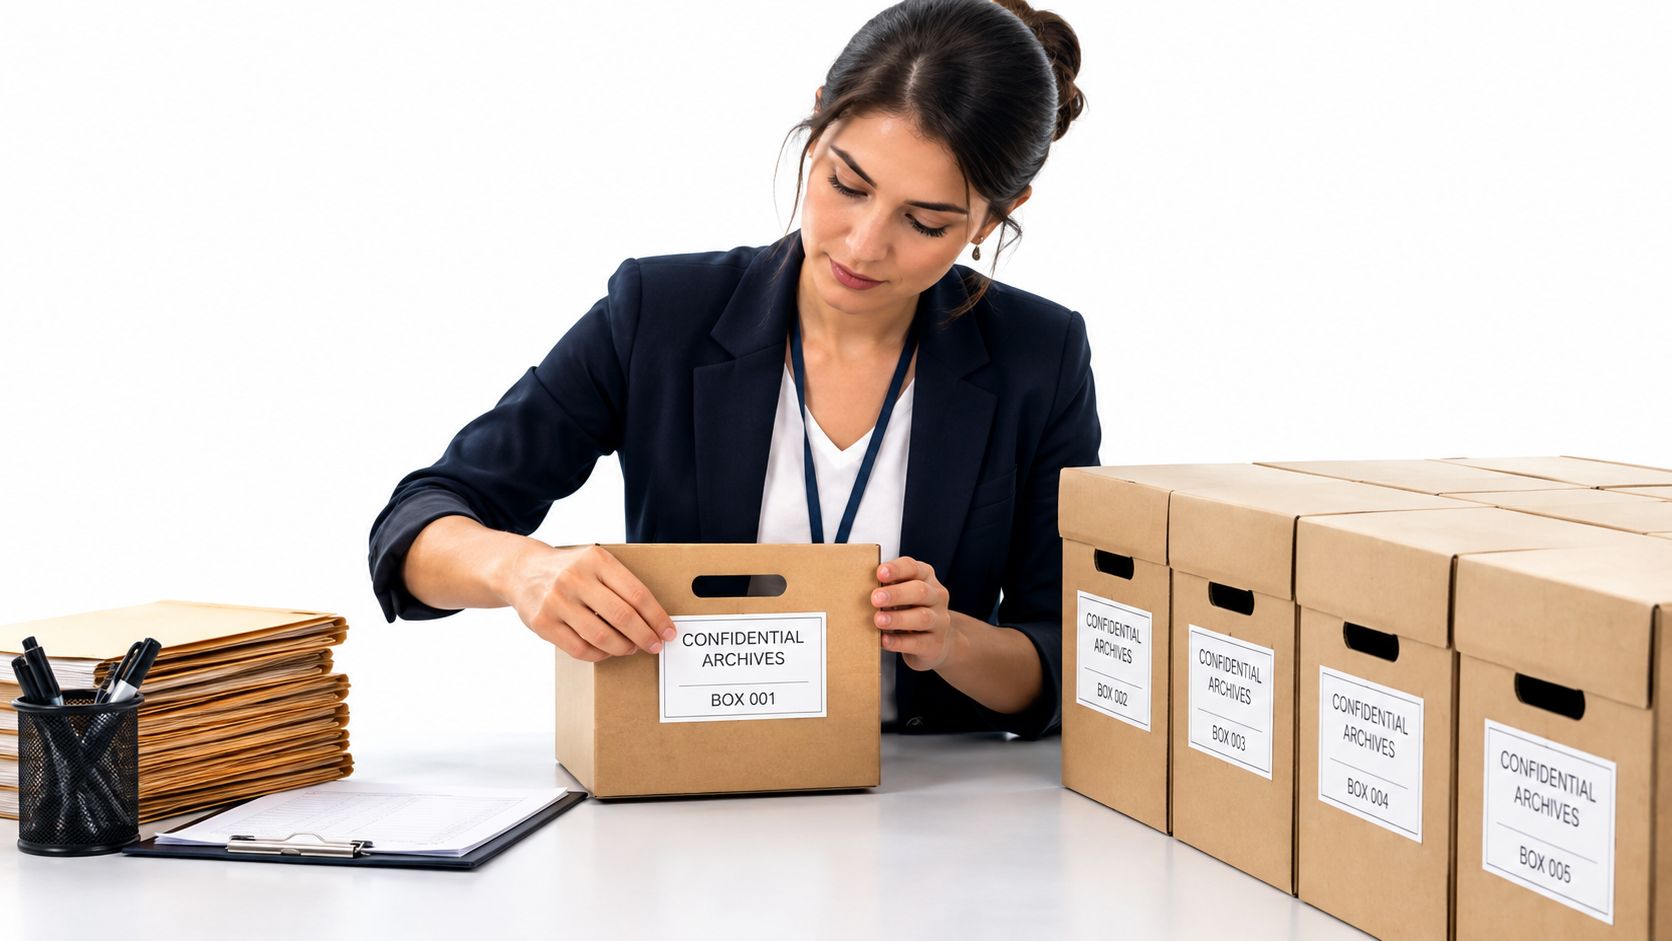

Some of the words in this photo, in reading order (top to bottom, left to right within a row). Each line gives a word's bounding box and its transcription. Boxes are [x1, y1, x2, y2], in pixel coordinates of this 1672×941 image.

[682, 630, 804, 646] CONFIDENTIAL
[1086, 613, 1142, 644] CONFIDENTIAL
[702, 652, 785, 667] ARCHIVES
[1094, 638, 1132, 664] ARCHIVES
[1199, 648, 1262, 684] CONFIDENTIAL
[712, 693, 745, 707] BOX
[750, 692, 775, 706] 001
[1098, 683, 1113, 701] BOX
[1114, 689, 1128, 707] 002
[1208, 677, 1251, 705] ARCHIVES
[1332, 693, 1408, 736] CONFIDENTIAL
[1213, 725, 1229, 745] BOX
[1232, 732, 1246, 751] 003
[1343, 724, 1395, 758] ARCHIVES
[1500, 750, 1596, 803] CONFIDENTIAL
[1347, 778, 1368, 800] BOX
[1371, 788, 1388, 809] 004
[1514, 787, 1580, 827] ARCHIVES
[1519, 846, 1545, 874] BOX
[1549, 859, 1571, 884] 005
